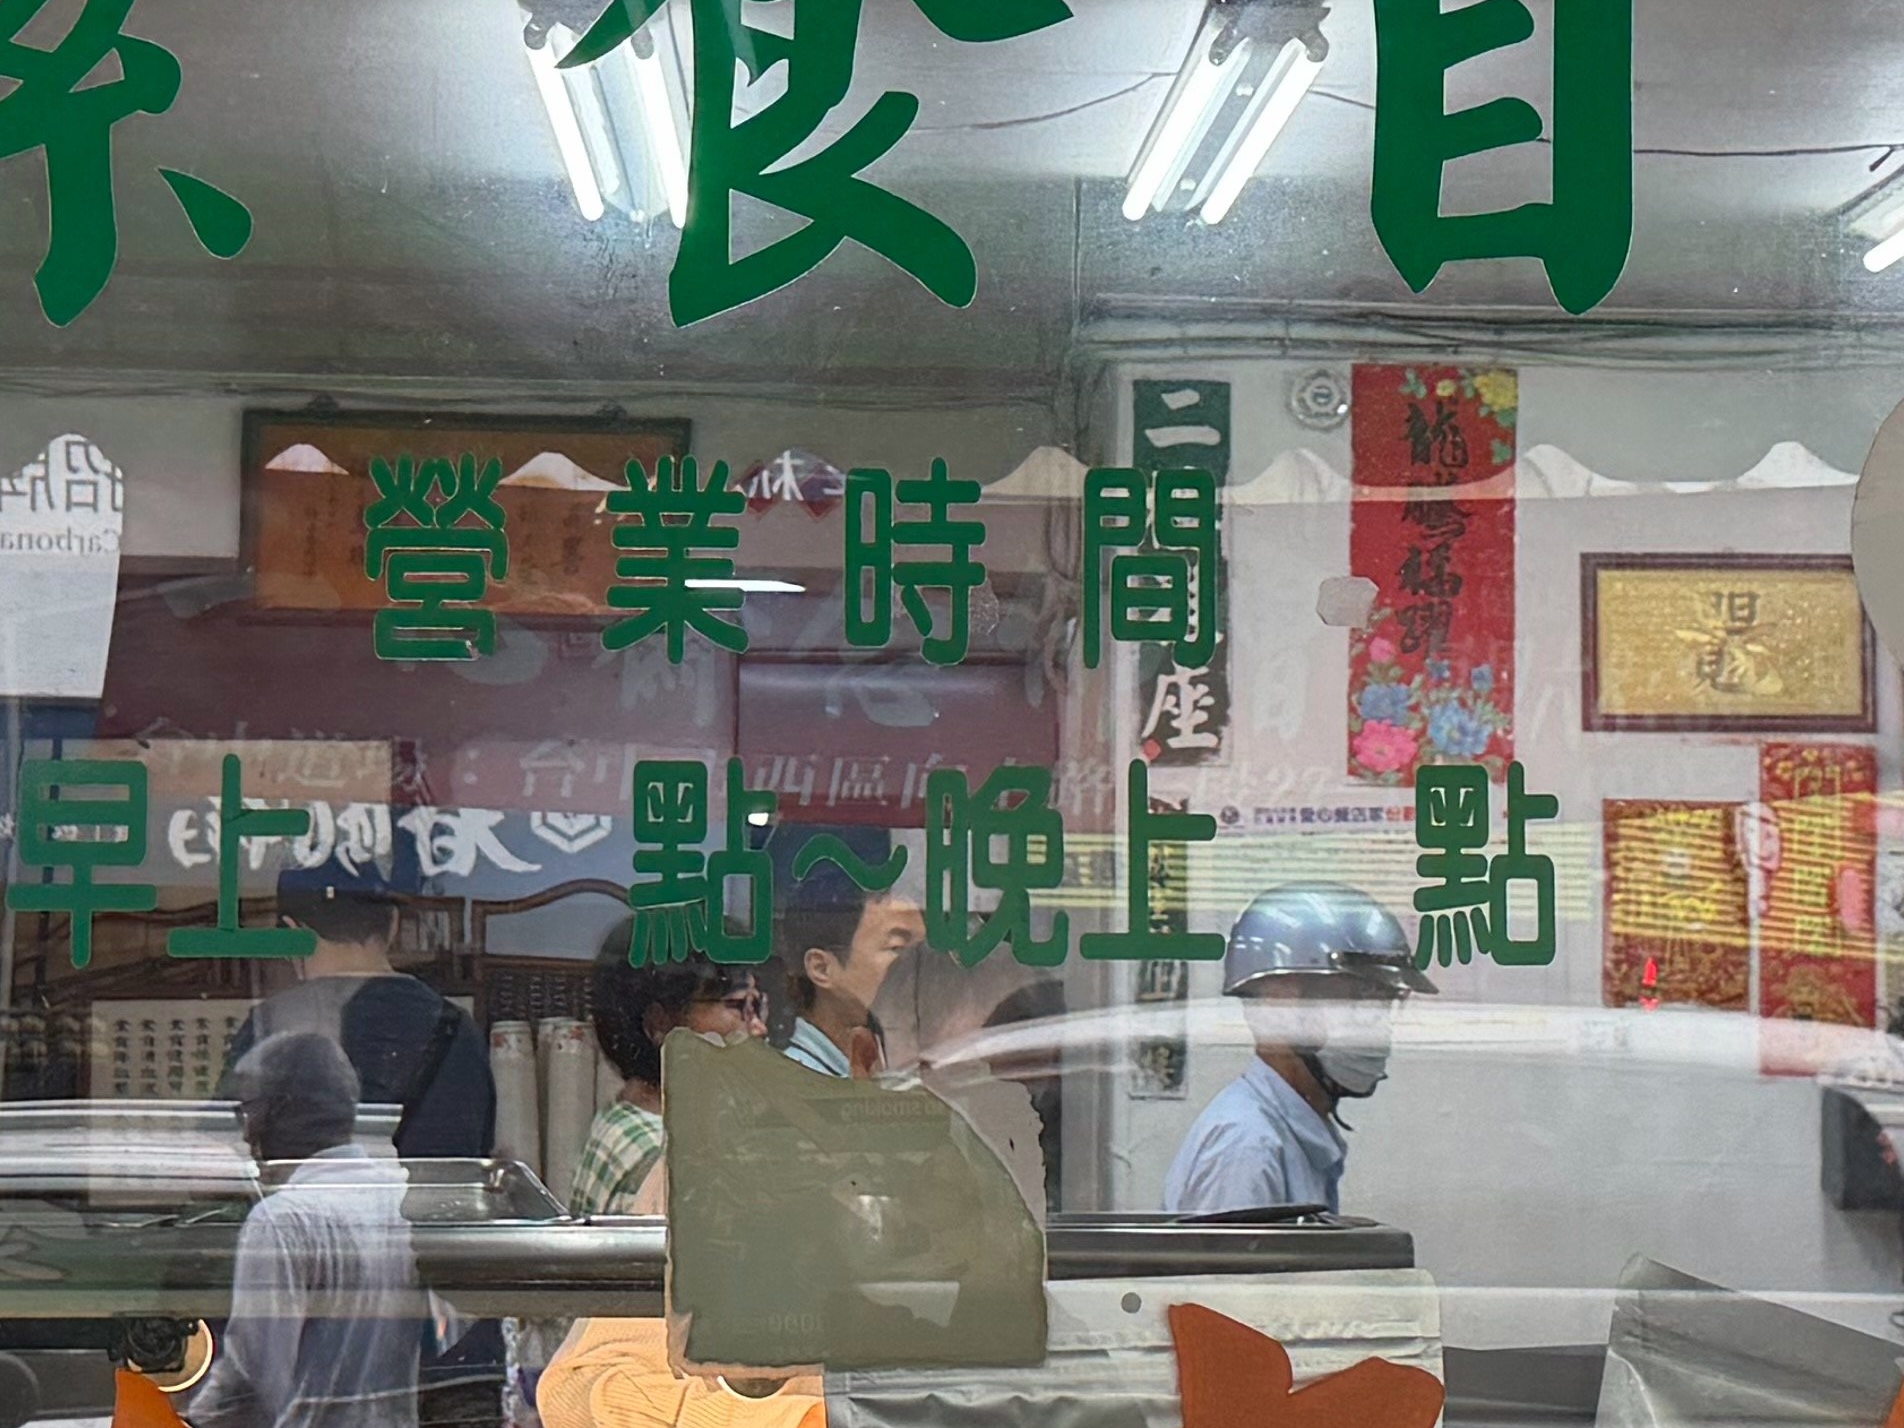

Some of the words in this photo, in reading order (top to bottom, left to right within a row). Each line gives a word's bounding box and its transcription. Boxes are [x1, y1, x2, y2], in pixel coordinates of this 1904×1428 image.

[364, 452, 1218, 670] 營業時間
[7, 754, 317, 969] 早上
